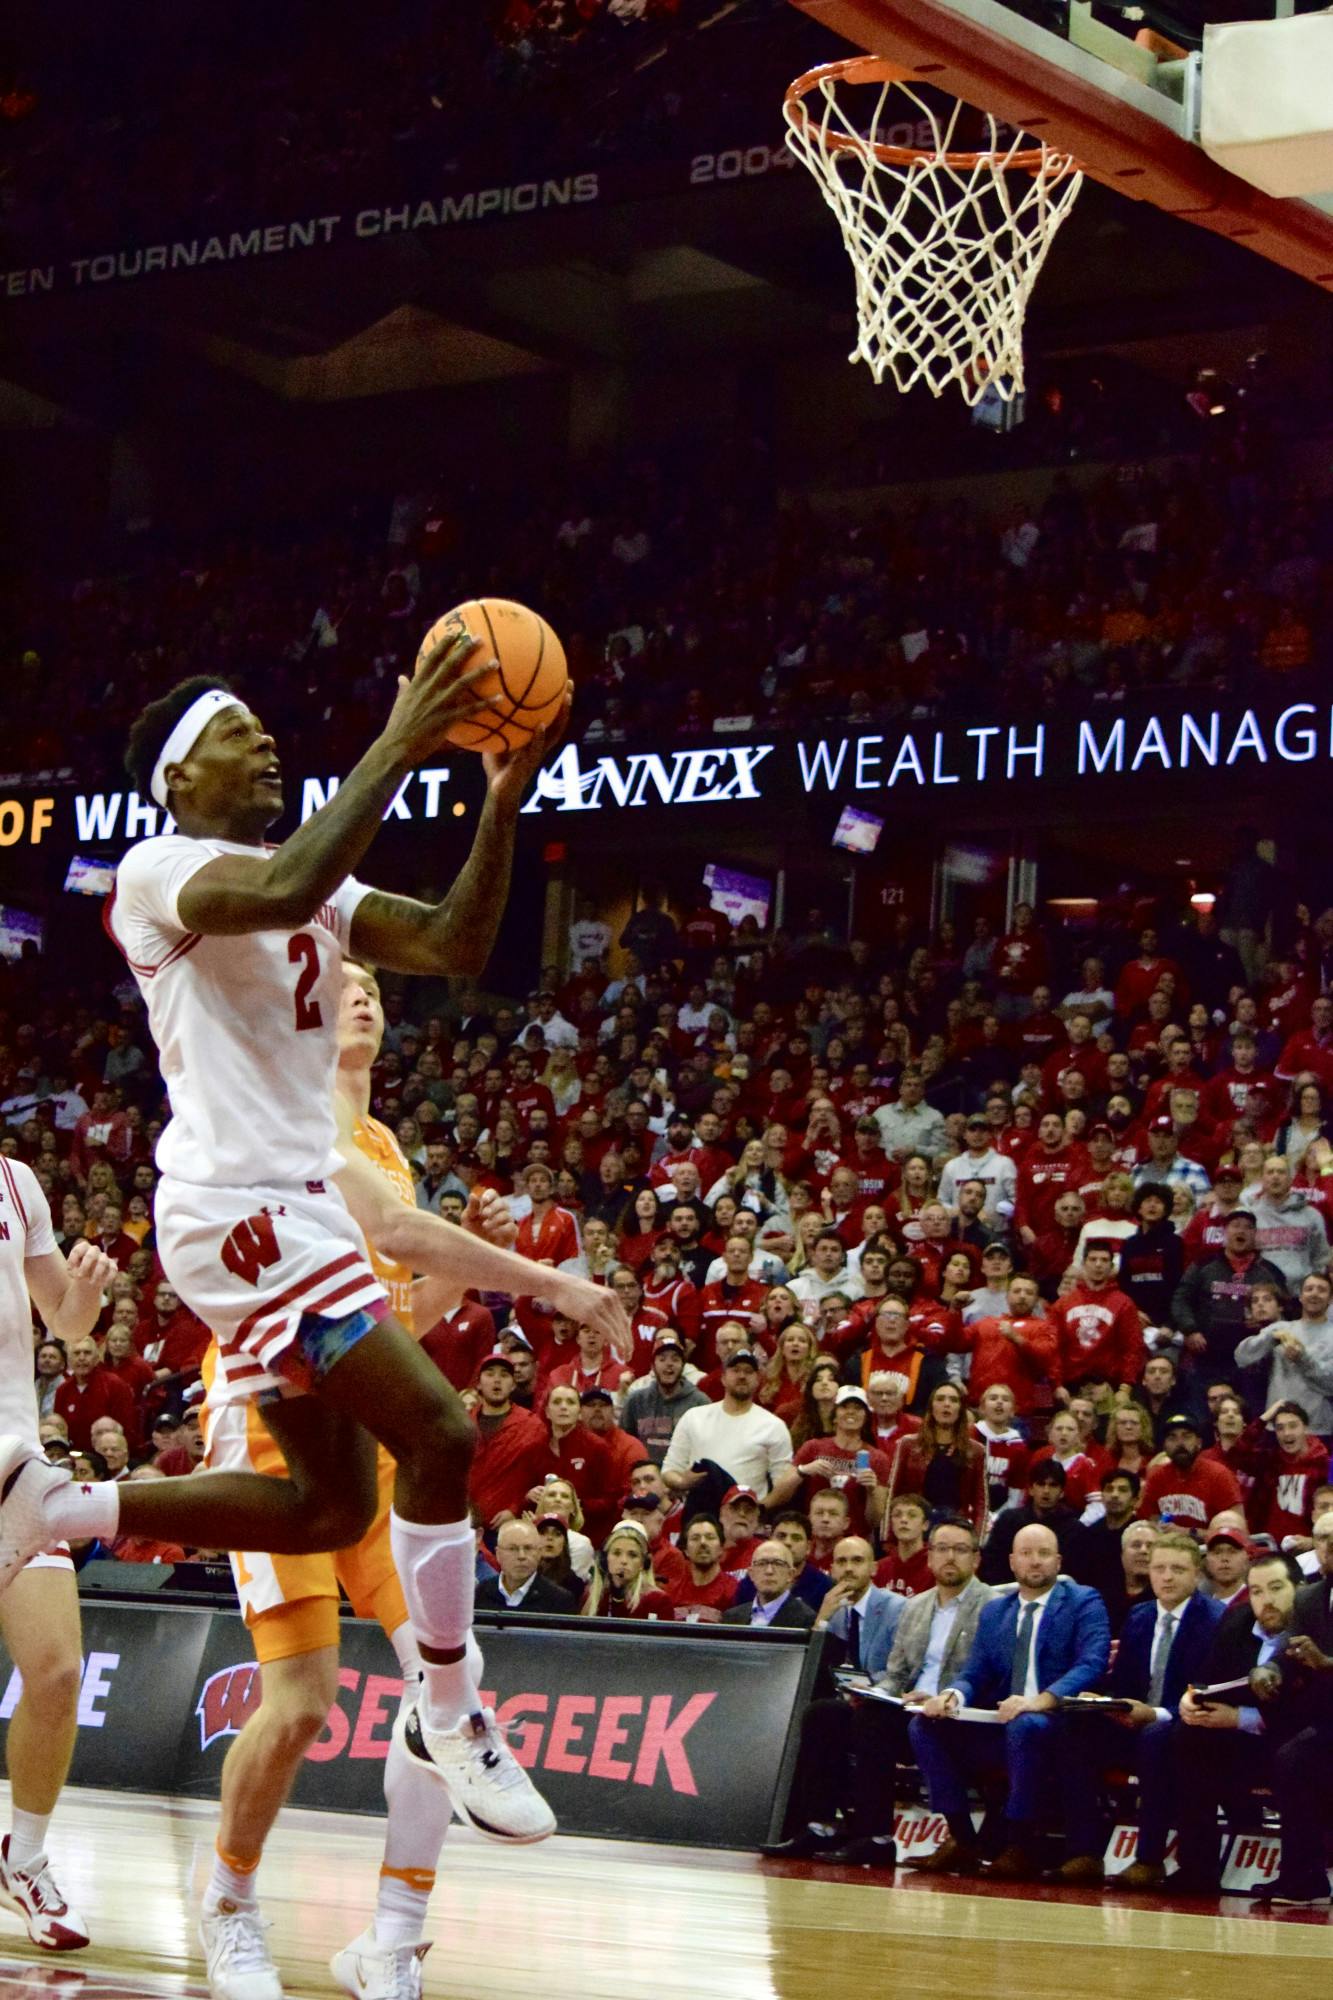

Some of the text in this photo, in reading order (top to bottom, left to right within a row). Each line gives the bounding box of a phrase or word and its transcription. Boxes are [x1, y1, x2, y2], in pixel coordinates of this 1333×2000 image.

[690, 148, 796, 184] 2004
[71, 214, 342, 286] TOURNAMENT
[355, 173, 599, 238] CHAMPIONS
[519, 743, 775, 814] ANNEX
[797, 703, 1333, 792] WEALTH MANAG
[0, 797, 54, 847] OF
[301, 768, 466, 825] NXT.
[880, 888, 904, 904] 121
[288, 933, 323, 1031] 2
[1276, 1474, 1307, 1516] W
[299, 1667, 719, 1796] SEGEEK
